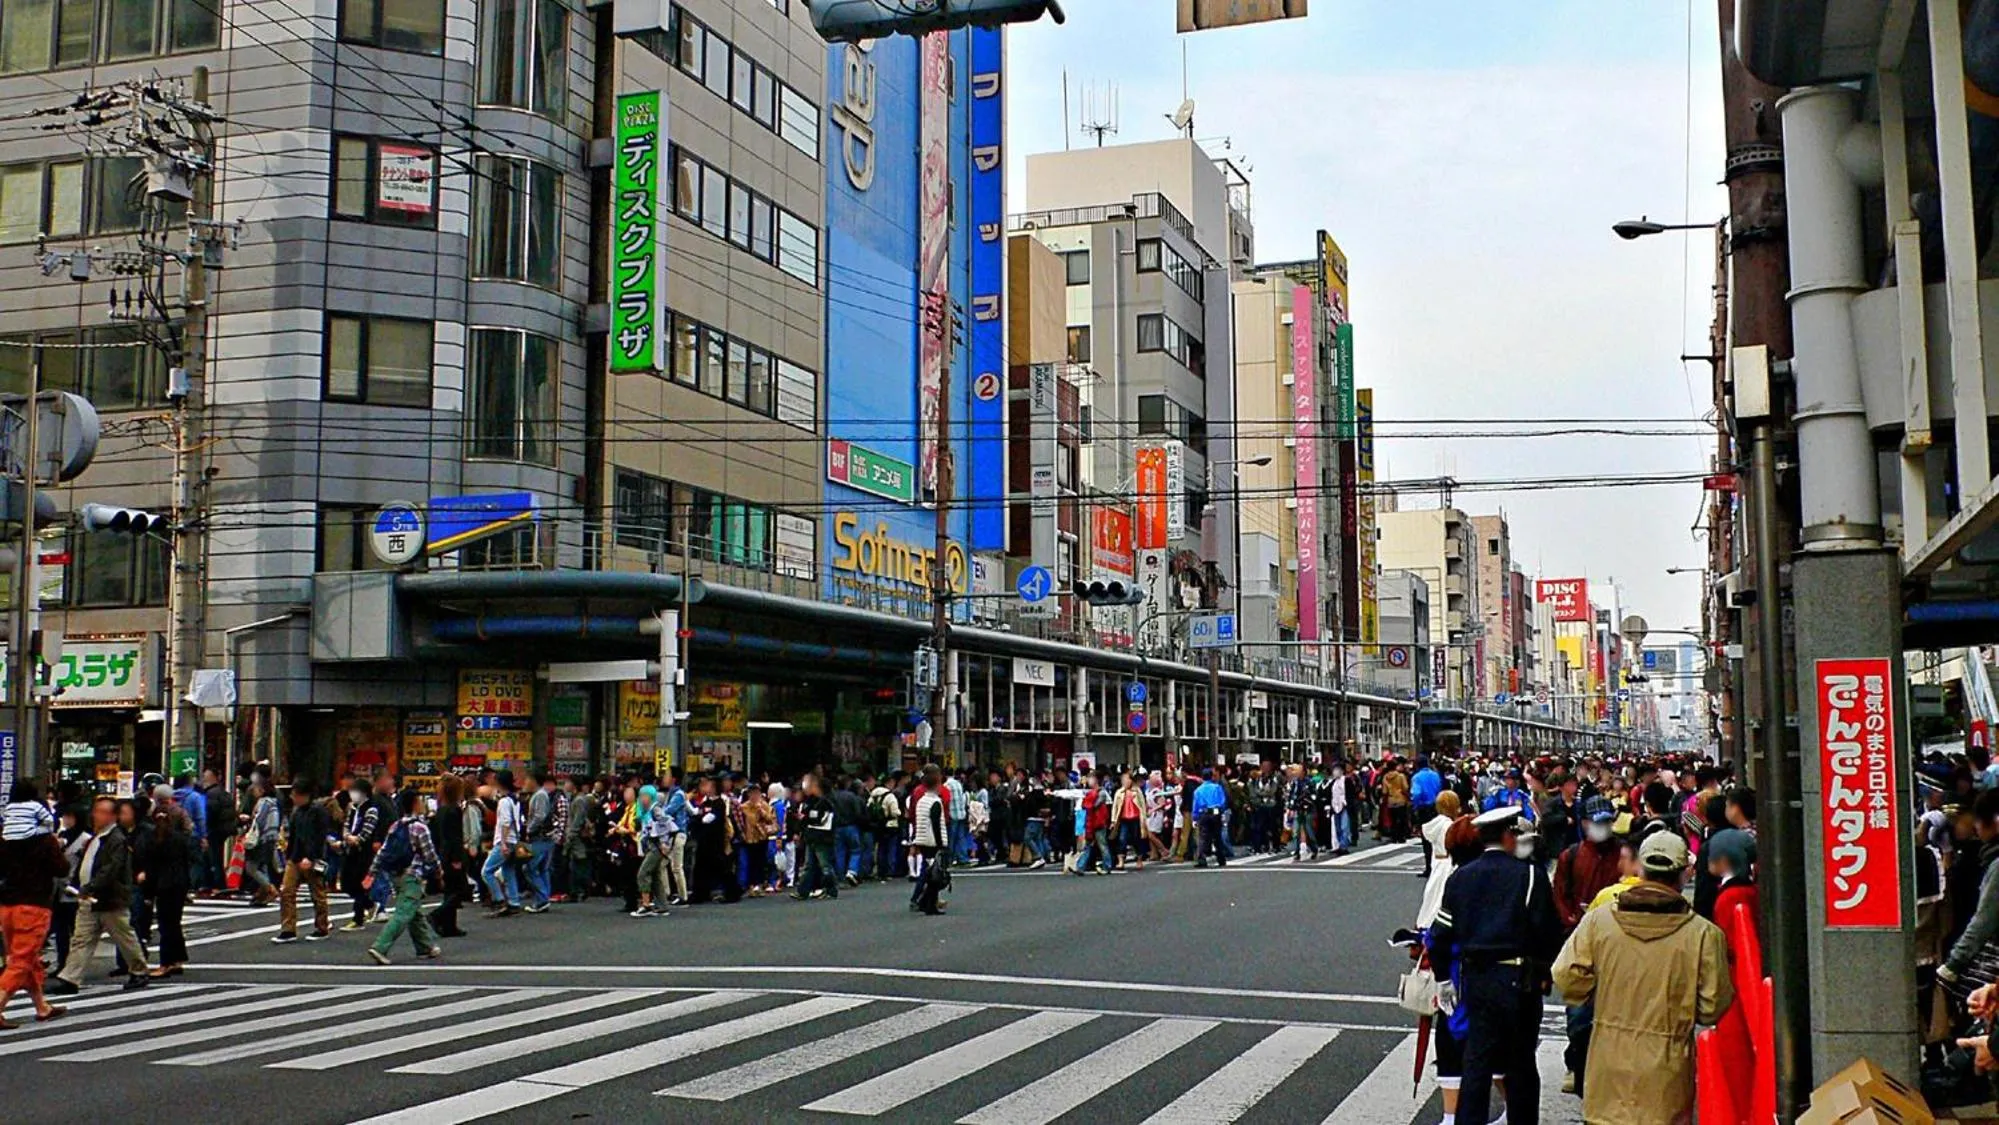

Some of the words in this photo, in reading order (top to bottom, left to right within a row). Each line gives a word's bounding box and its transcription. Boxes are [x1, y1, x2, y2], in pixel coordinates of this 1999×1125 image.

[617, 133, 655, 359] ディスクプラザ
[980, 376, 994, 397] 2
[388, 534, 406, 554] 西
[1300, 517, 1313, 573] パソコン
[1542, 582, 1580, 595] DISC
[1025, 664, 1044, 680] NEC
[1436, 651, 1444, 684] TRUST
[1863, 675, 1890, 829] 電気のまち日本橋
[182, 757, 196, 773] 文
[417, 762, 432, 773] 2F
[1824, 675, 1868, 910] でんでんタウン
